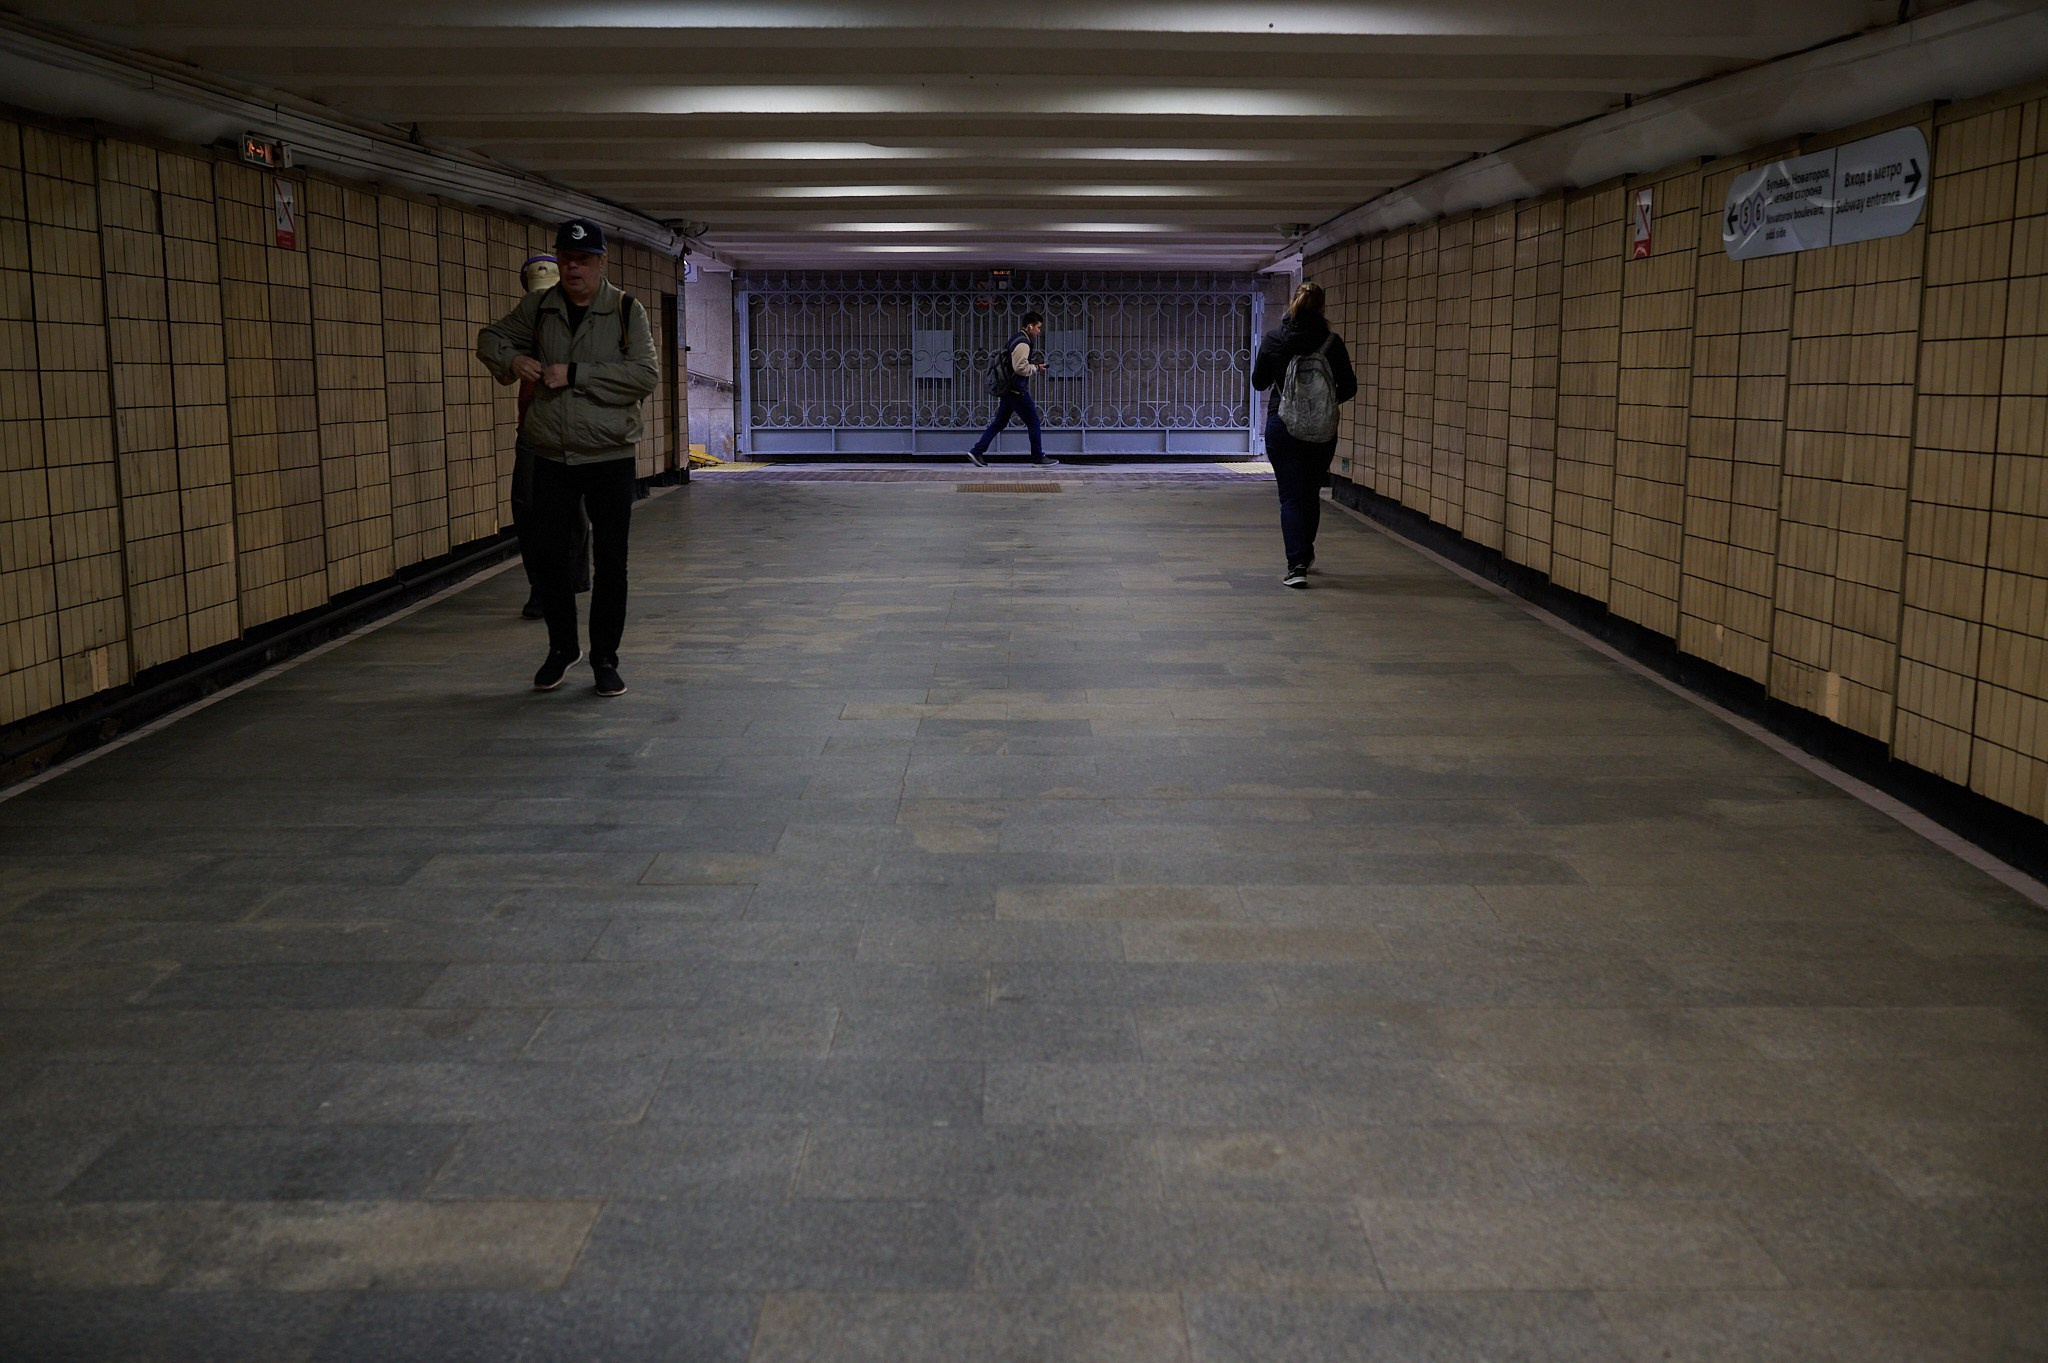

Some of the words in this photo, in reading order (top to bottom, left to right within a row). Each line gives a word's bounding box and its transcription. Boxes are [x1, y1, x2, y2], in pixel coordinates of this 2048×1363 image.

[1845, 172, 1866, 187] Вход
[1867, 170, 1873, 182] в
[1874, 163, 1902, 182] метро
[1744, 207, 1749, 224] 5
[1756, 203, 1761, 221] 6
[1836, 197, 1865, 214] Subway
[1866, 190, 1900, 207] entrance
